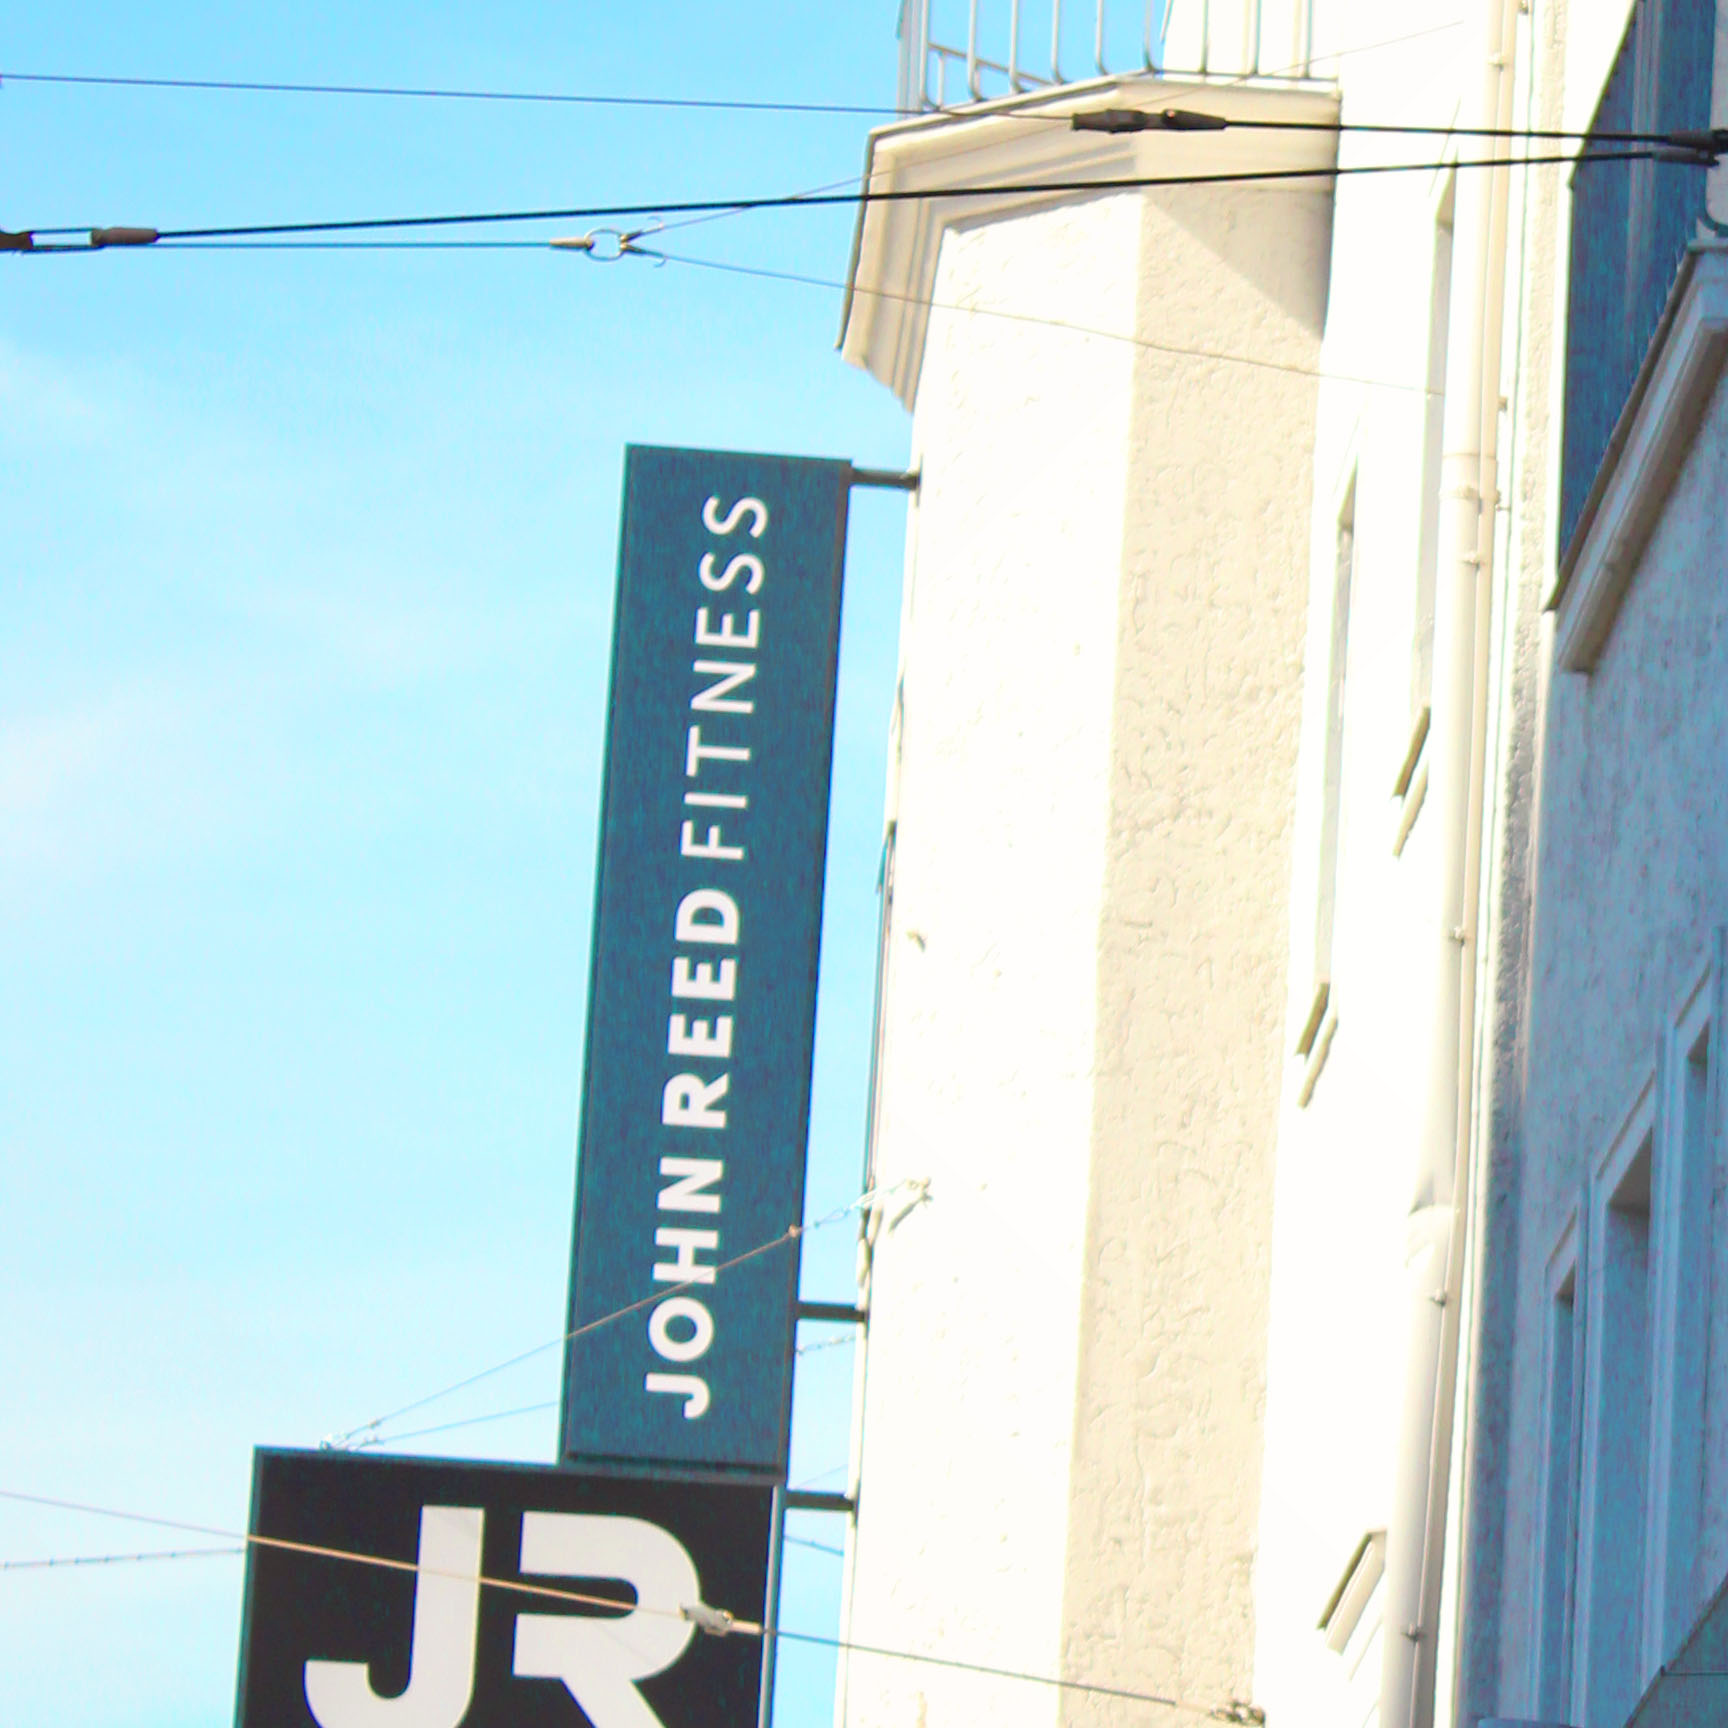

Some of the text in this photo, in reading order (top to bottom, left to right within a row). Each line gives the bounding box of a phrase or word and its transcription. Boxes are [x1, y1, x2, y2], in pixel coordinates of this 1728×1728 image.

[645, 493, 769, 1420] JOHN REED FITNESS
